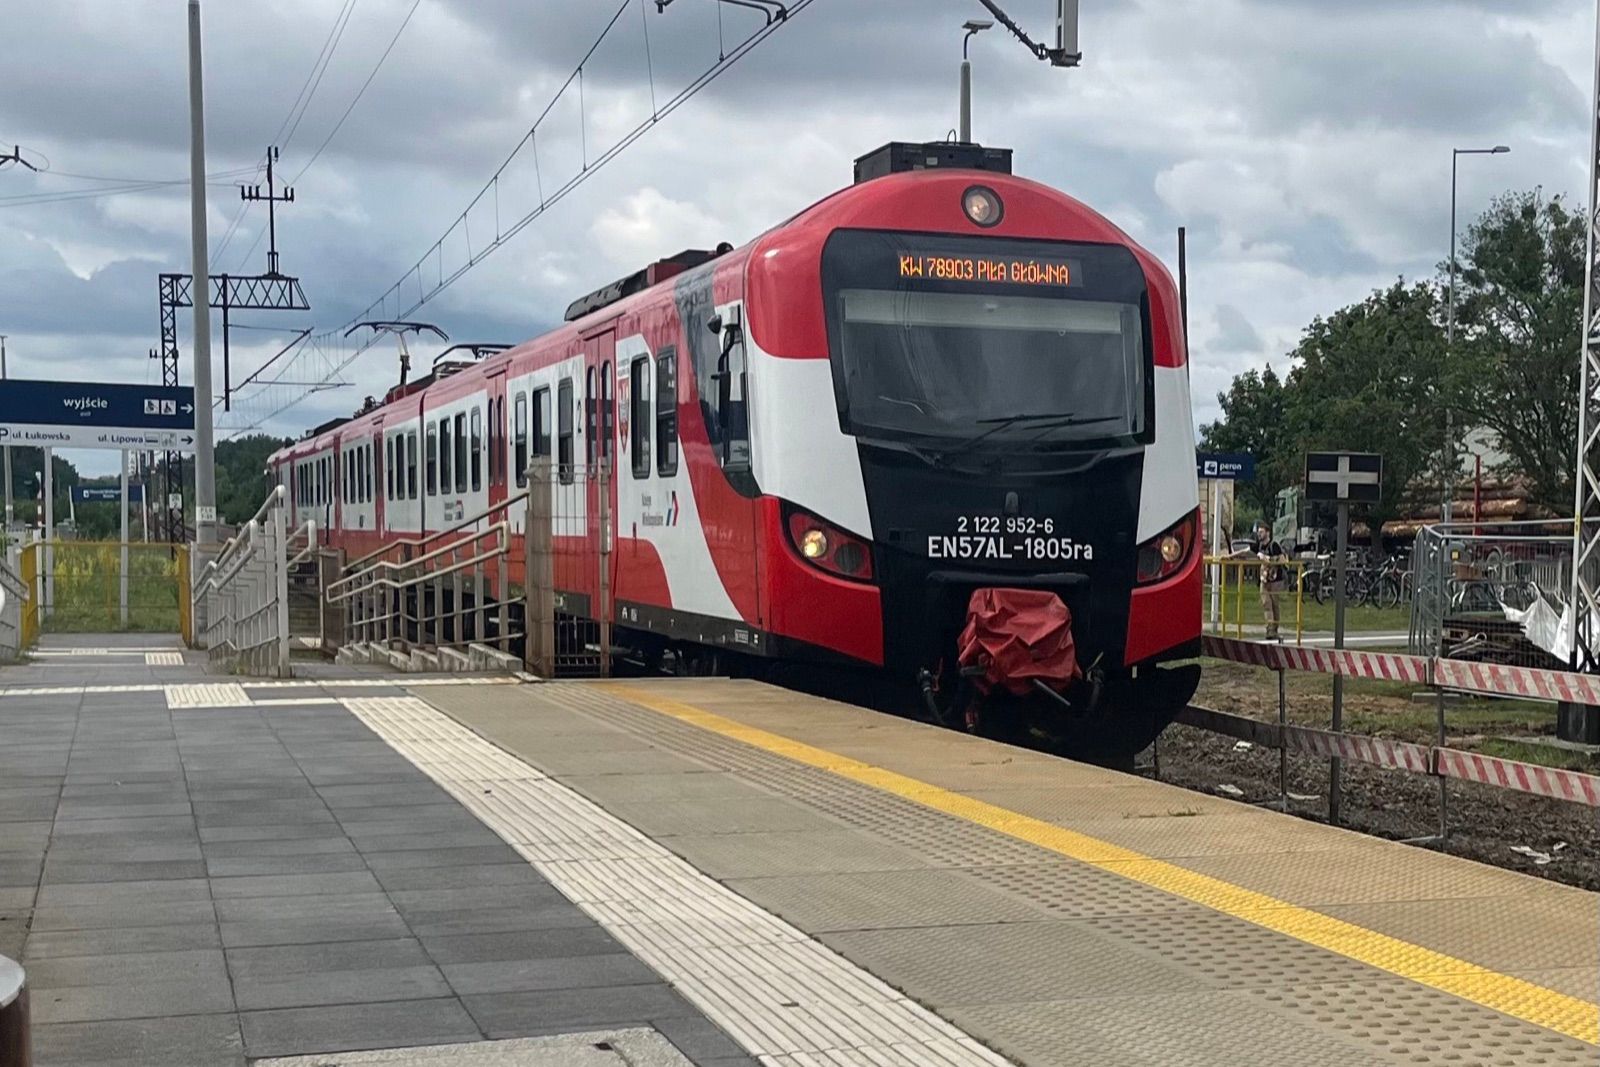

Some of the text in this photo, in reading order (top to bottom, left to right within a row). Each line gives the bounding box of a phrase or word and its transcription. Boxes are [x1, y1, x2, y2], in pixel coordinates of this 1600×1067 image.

[900, 256, 1070, 285] KW 78903 PIŁA GŁÓWNA
[63, 396, 108, 410] wyjście
[1219, 463, 1242, 471] peron
[957, 516, 1054, 534] 2 122 952-6
[927, 535, 1093, 560] EN57AL-1805ra
